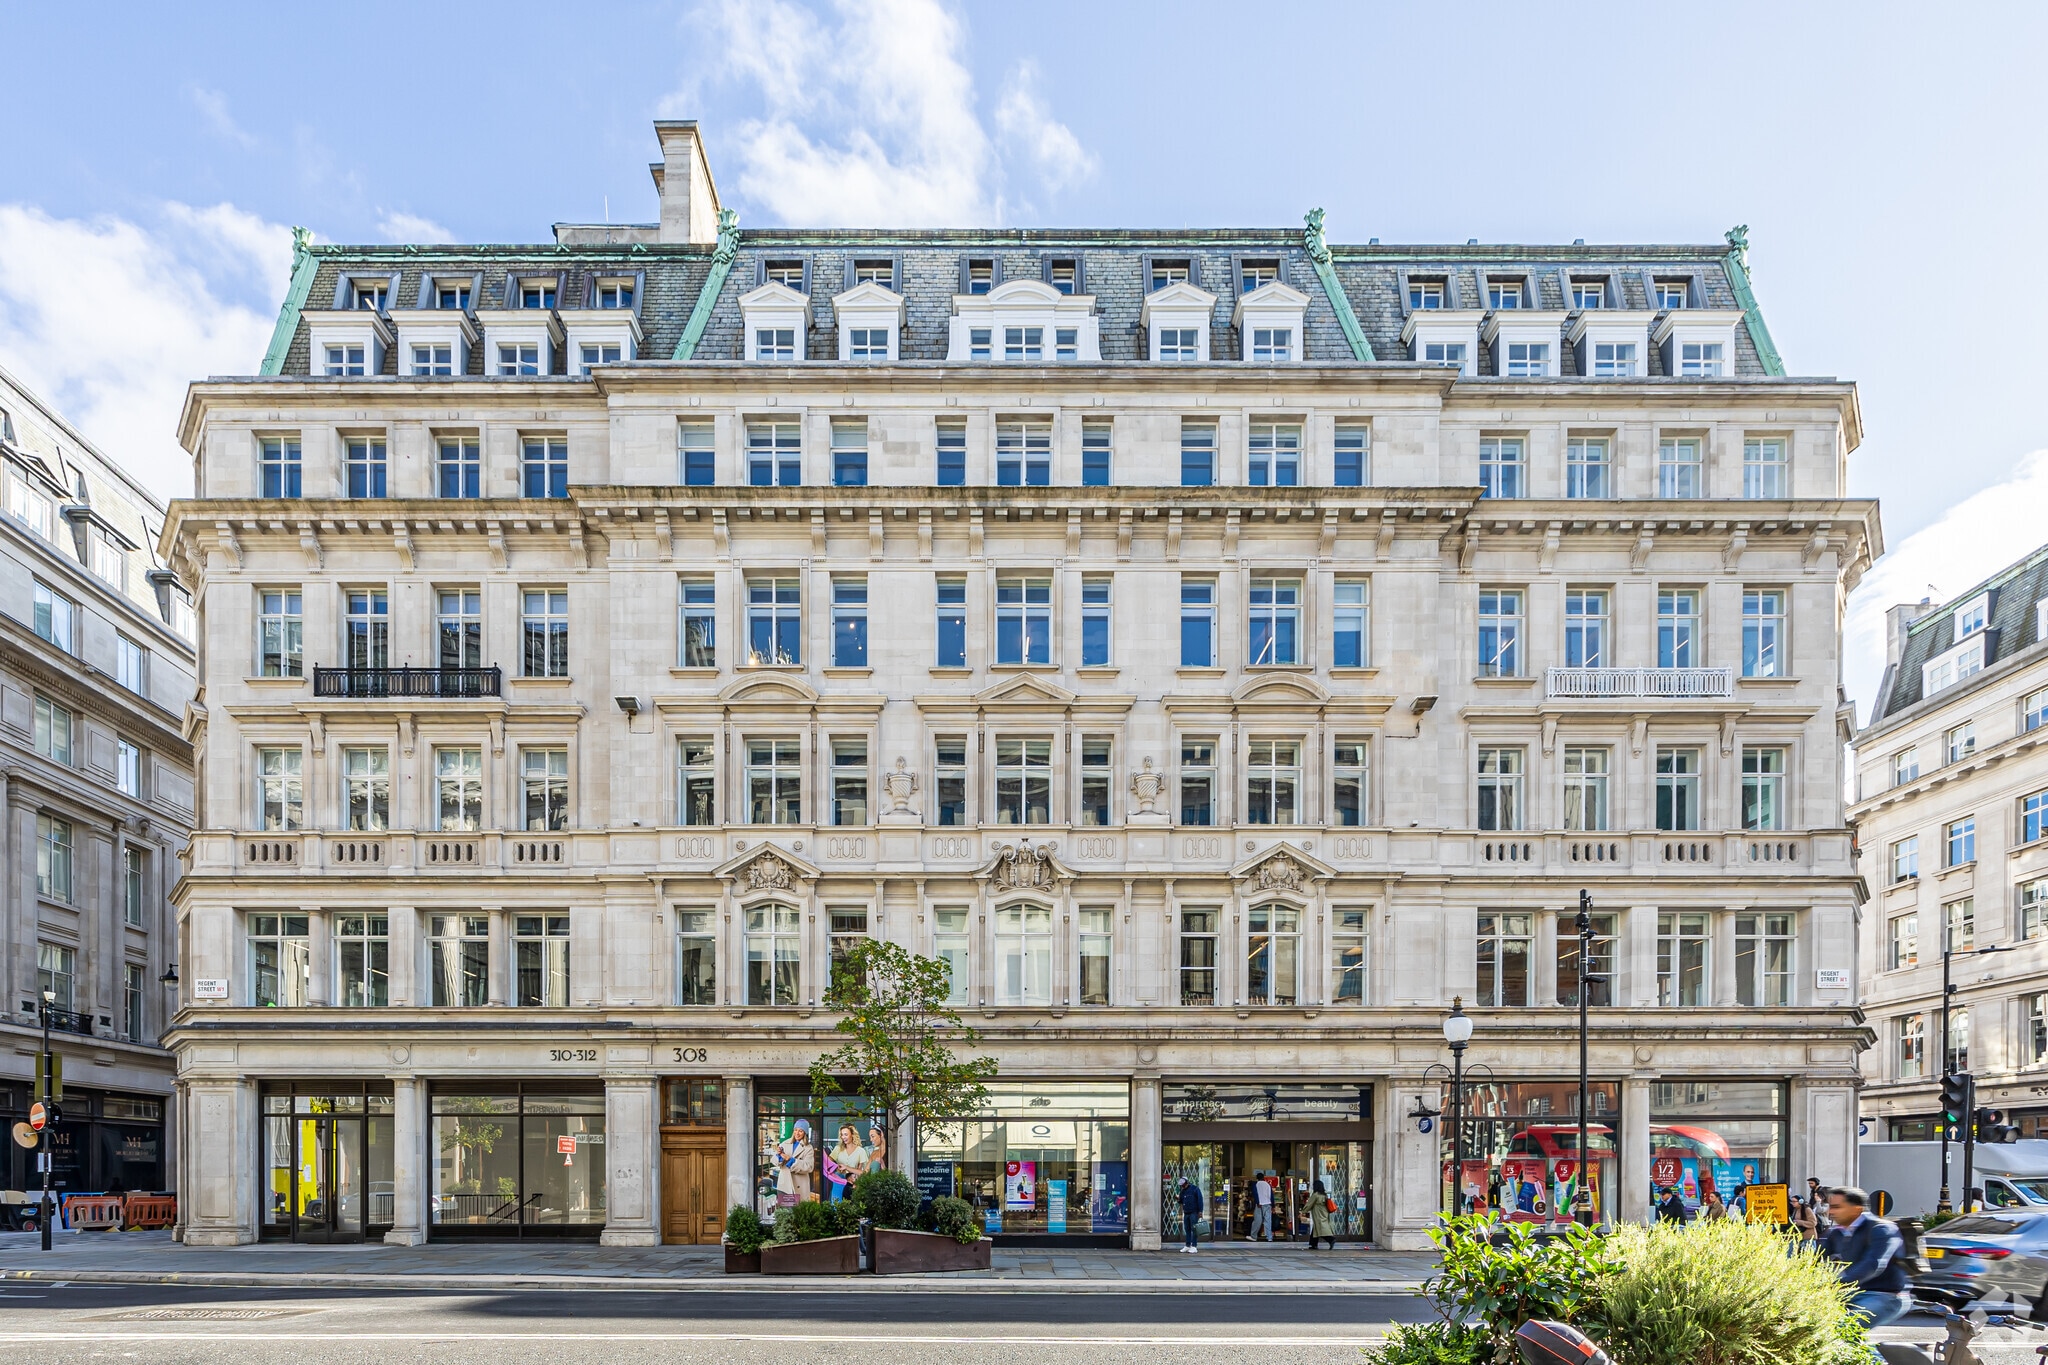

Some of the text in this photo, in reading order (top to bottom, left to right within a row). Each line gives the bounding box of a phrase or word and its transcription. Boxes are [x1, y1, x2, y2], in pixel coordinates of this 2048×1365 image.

[550, 1049, 597, 1061] 310-312
[672, 1047, 707, 1063] 308
[1176, 1098, 1225, 1110] pharmacy
[1304, 1098, 1339, 1110] beauty
[917, 1166, 950, 1174] welcome
[1658, 1164, 1674, 1174] 1/2
